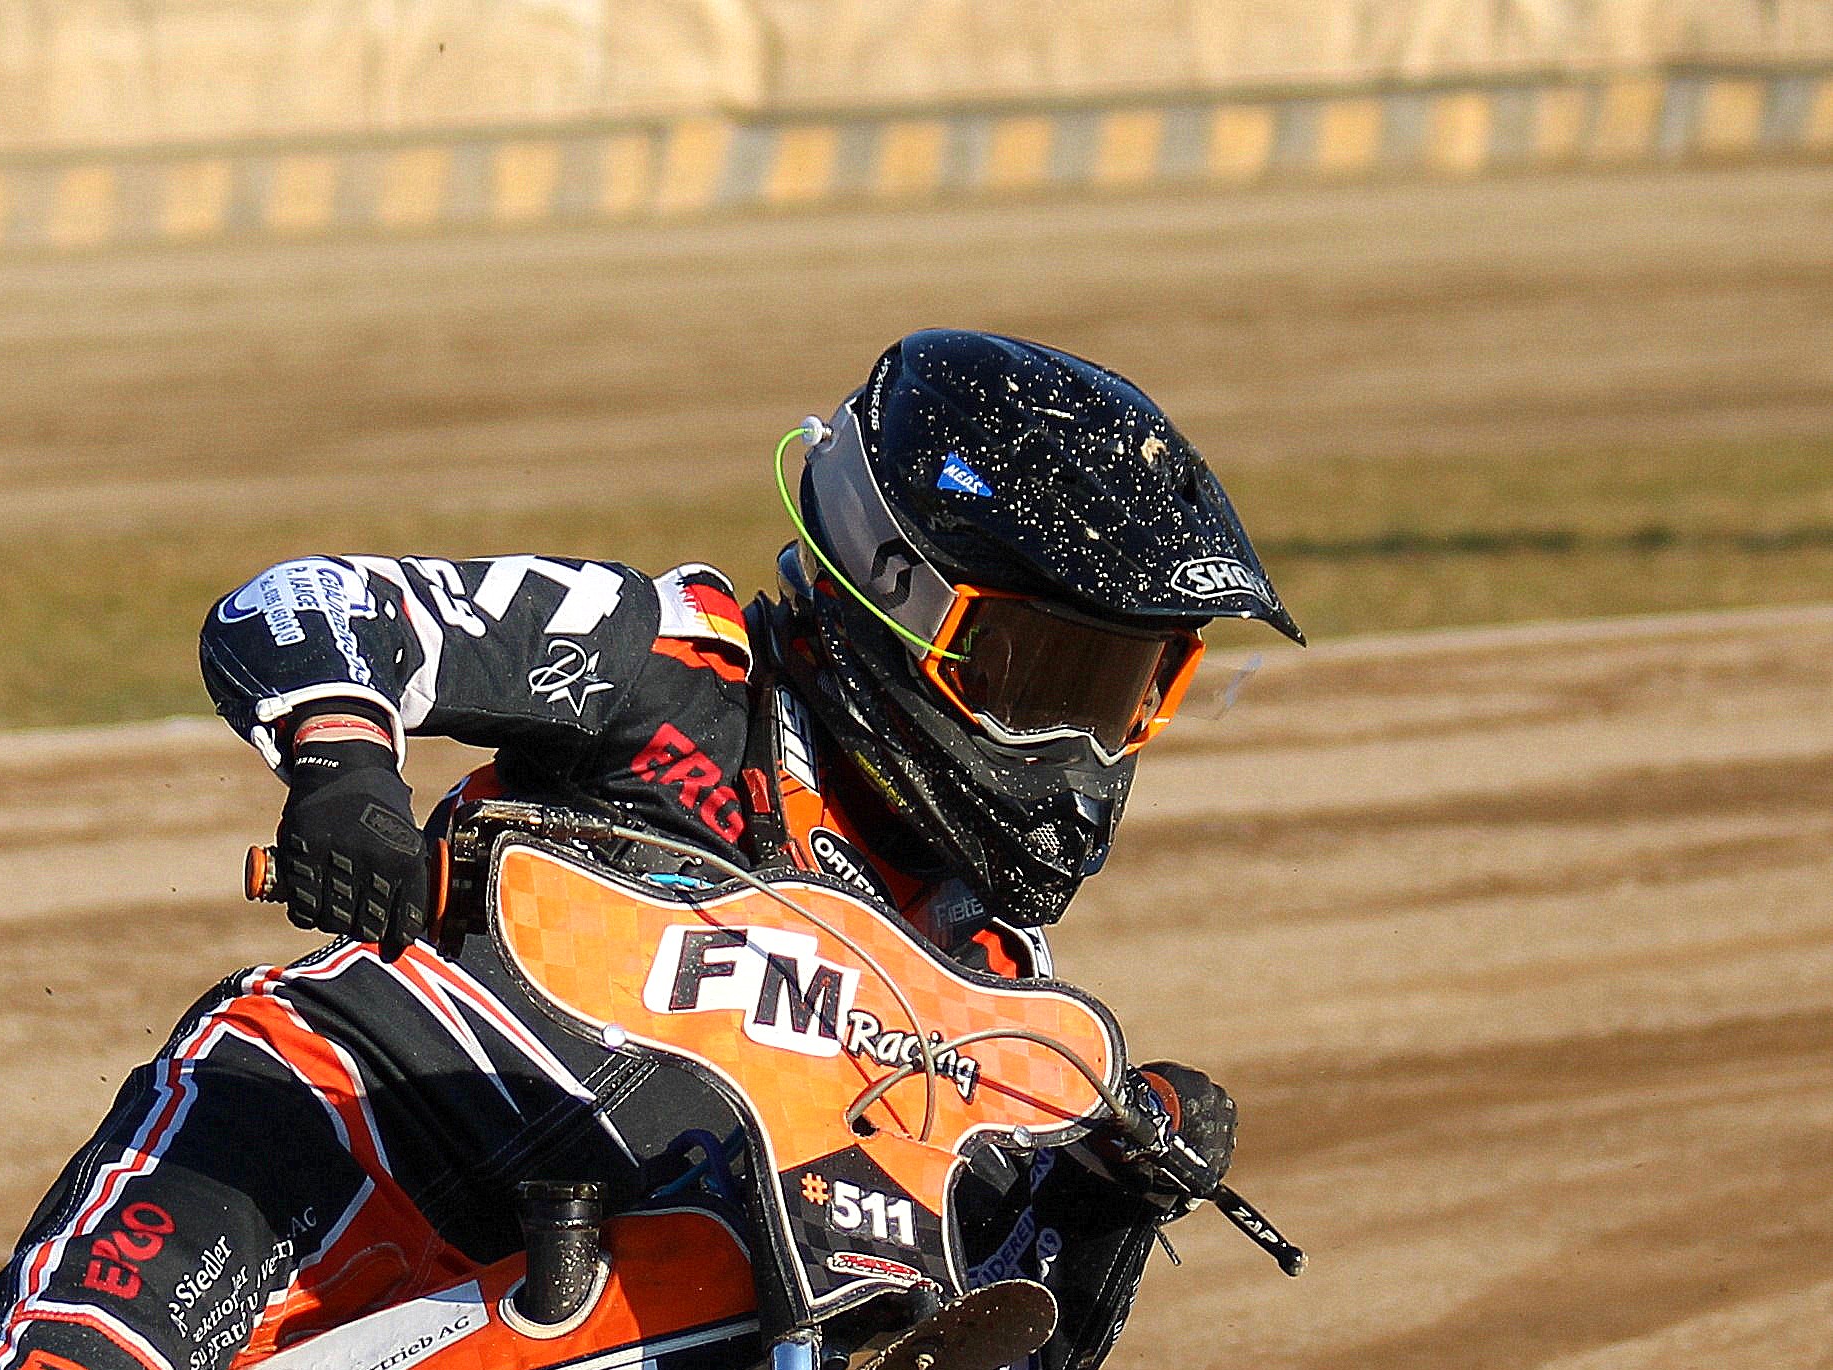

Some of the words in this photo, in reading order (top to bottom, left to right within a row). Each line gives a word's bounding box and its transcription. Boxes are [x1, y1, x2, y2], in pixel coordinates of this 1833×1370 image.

[1186, 563, 1274, 603] SHO
[814, 835, 885, 903] ORTE
[668, 928, 845, 1040] FM
[800, 1172, 916, 1246] #511
[1230, 1206, 1279, 1244] ZAP
[175, 1236, 232, 1308] Siedler
[438, 1315, 471, 1340] AG
